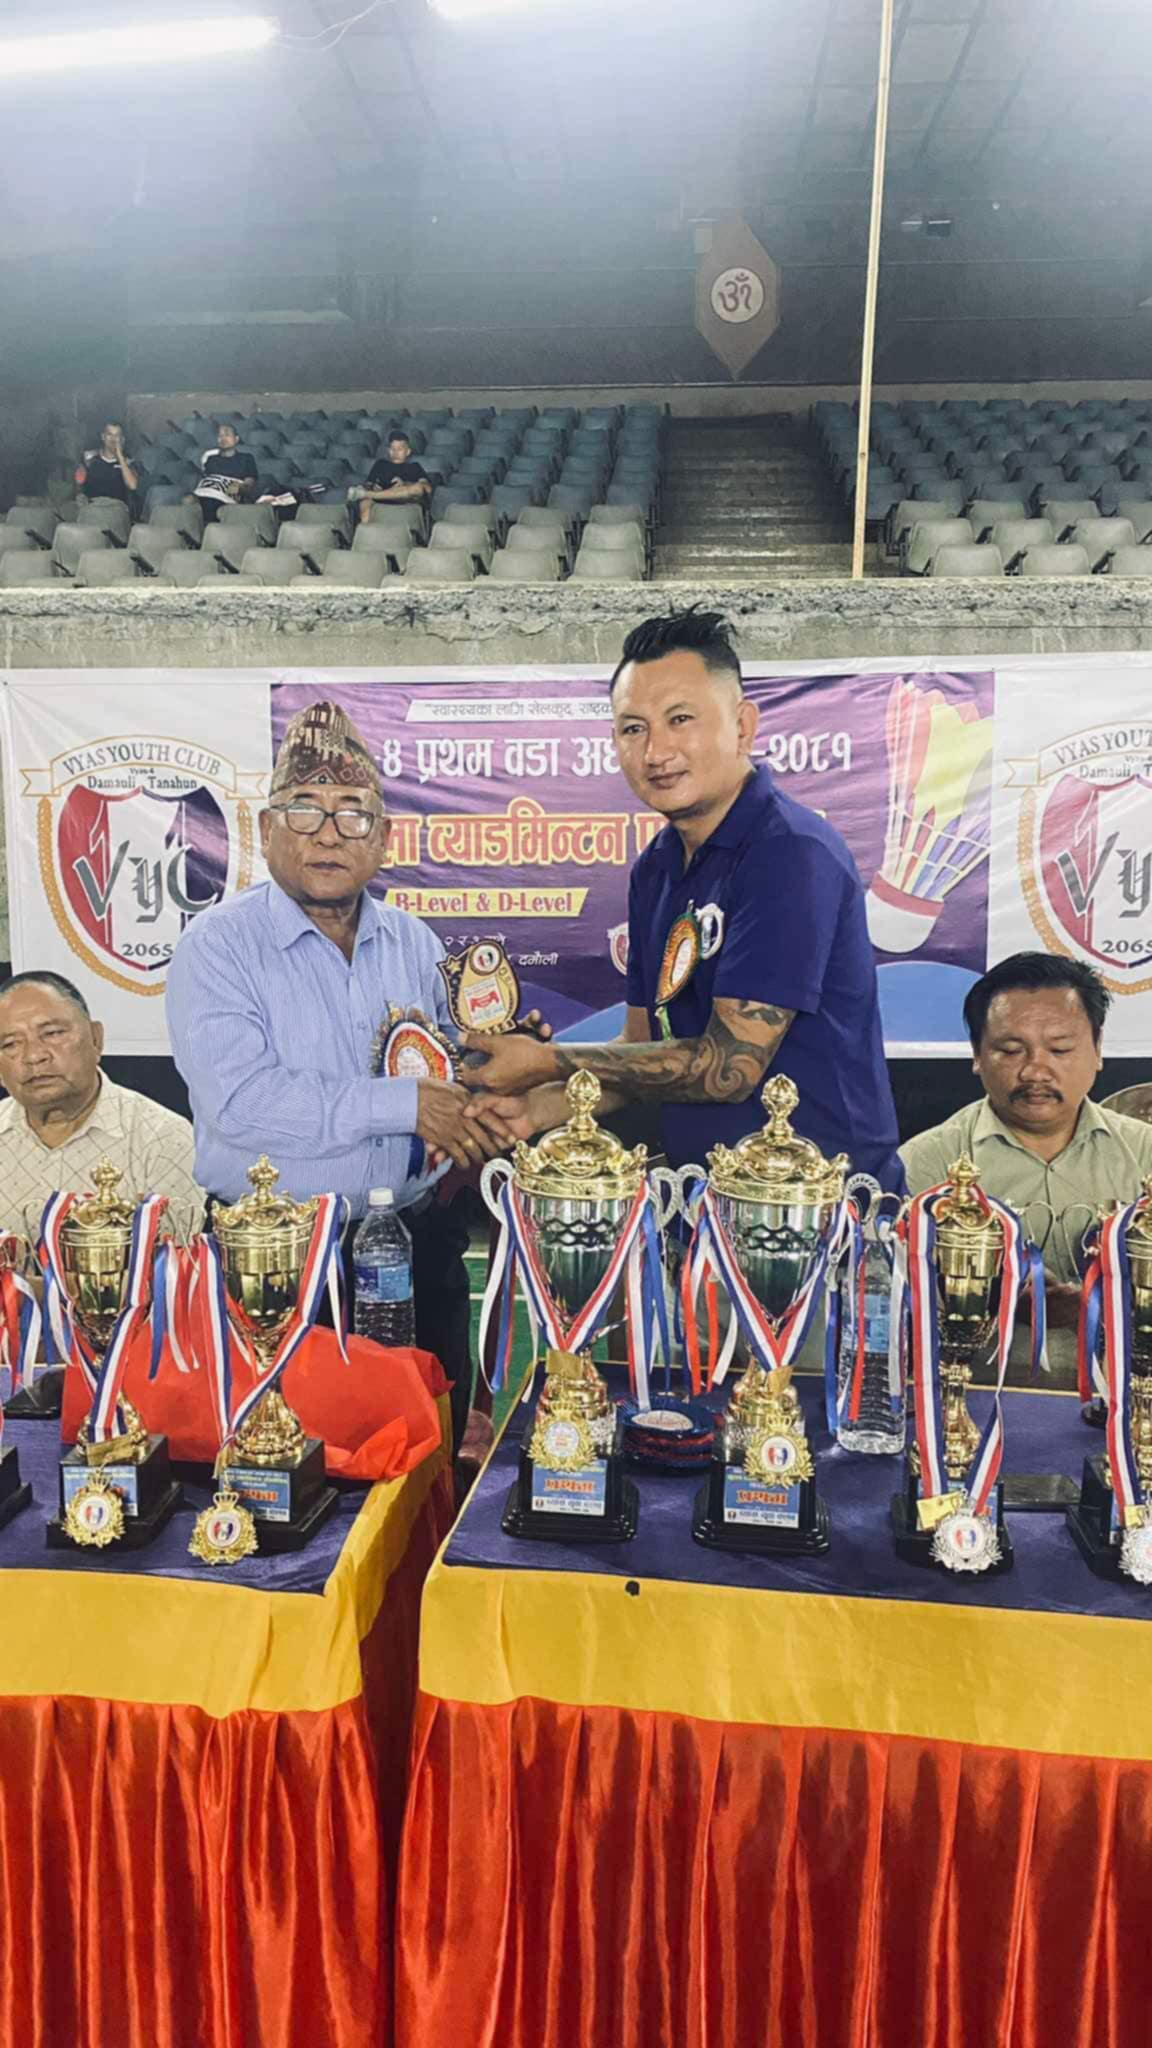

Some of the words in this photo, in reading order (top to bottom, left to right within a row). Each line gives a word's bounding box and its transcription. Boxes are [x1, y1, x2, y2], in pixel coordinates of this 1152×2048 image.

[63, 747, 106, 776] VYAS
[106, 742, 170, 763] YOUTH
[174, 747, 221, 776] CLUB
[416, 738, 495, 784] प्रथम
[503, 737, 561, 777] वडा
[749, 731, 853, 773] -२०८१
[1053, 735, 1100, 766] VYAS
[1101, 728, 1152, 750] YOUT
[88, 775, 136, 789] Damauli
[148, 775, 197, 789] Tanahun
[394, 892, 468, 912] B-Level
[476, 892, 490, 912] &
[499, 892, 572, 912] D-Level
[122, 943, 174, 957] 2065
